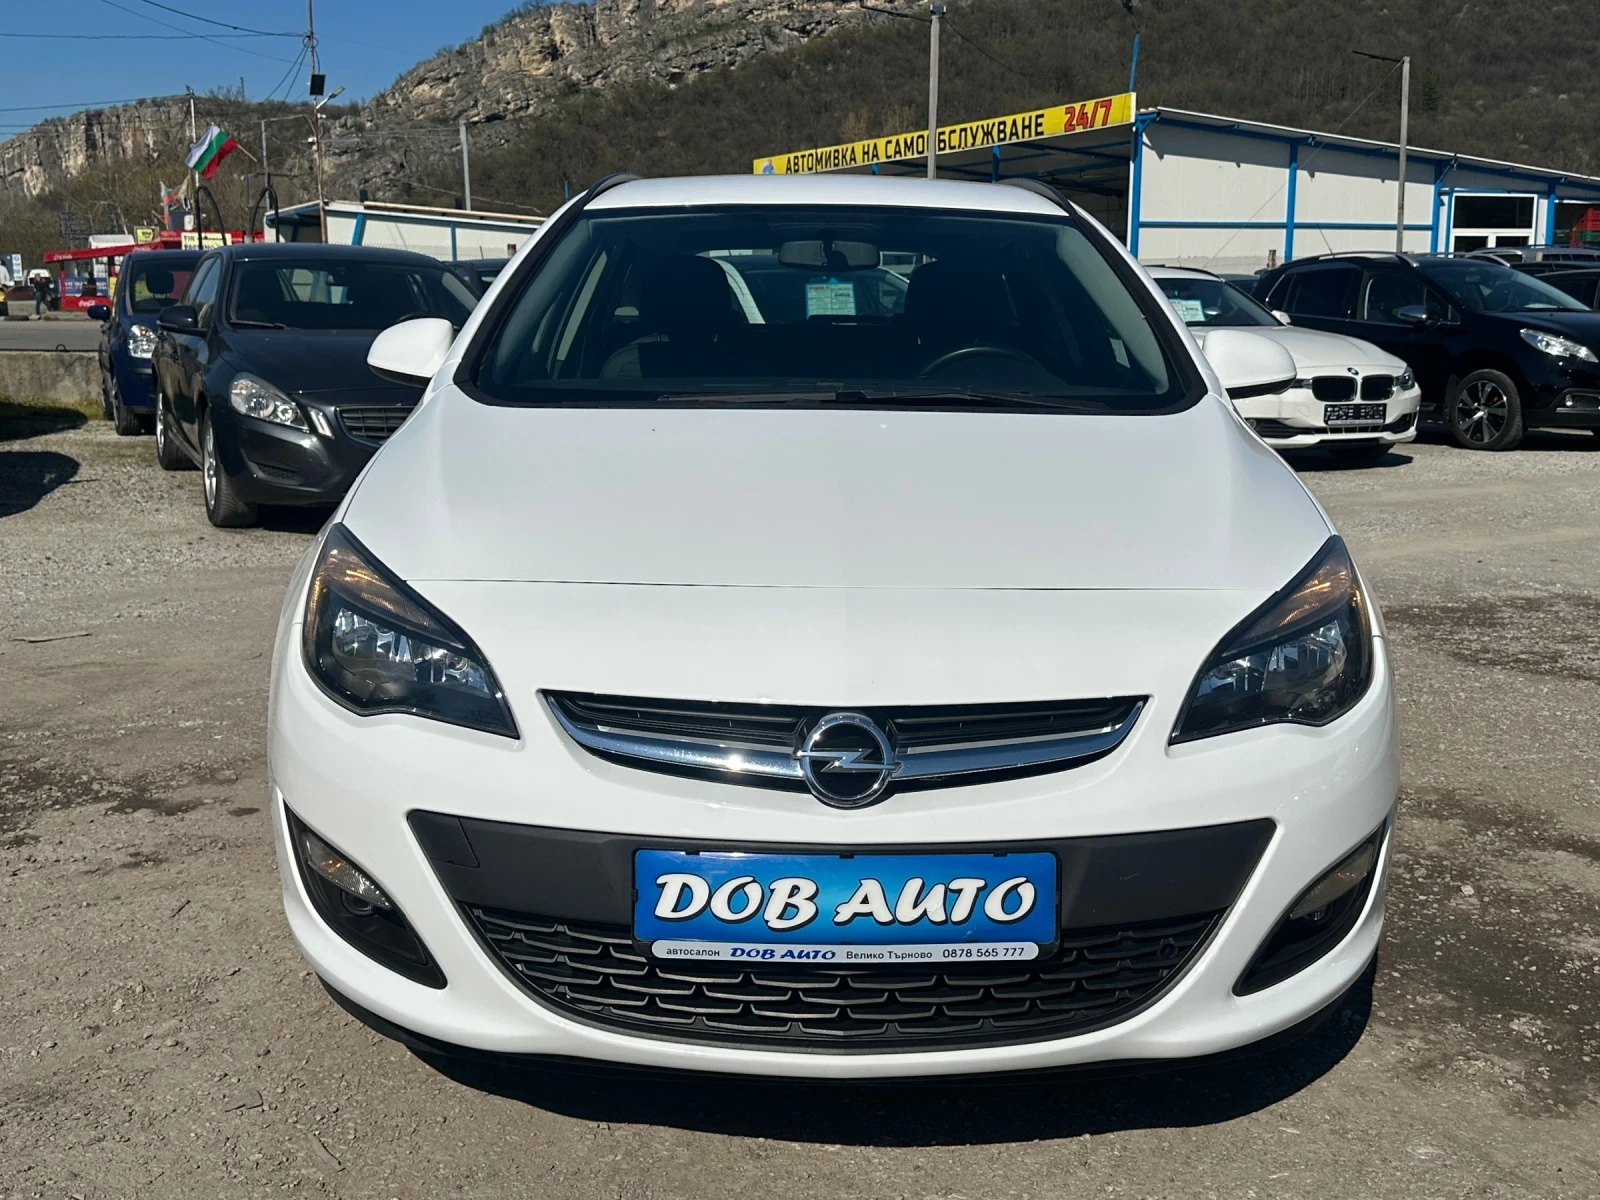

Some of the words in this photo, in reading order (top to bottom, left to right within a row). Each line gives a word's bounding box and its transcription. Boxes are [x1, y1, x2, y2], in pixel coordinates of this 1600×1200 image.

[785, 146, 857, 174] АВТОМИВКА
[862, 138, 880, 163] НА
[884, 113, 1045, 159] САМОБСЛУЖВАНЕ
[1063, 98, 1113, 133] 24/7
[654, 873, 819, 930] DOB
[833, 876, 1036, 927] AUTO
[666, 947, 720, 957] автосалон
[730, 947, 776, 960] DOB
[780, 949, 837, 961] AUTO
[846, 950, 885, 960] Велико
[887, 950, 933, 961] Търново
[942, 948, 973, 959] 0878
[976, 948, 999, 958] 565
[1003, 947, 1025, 957] 777
